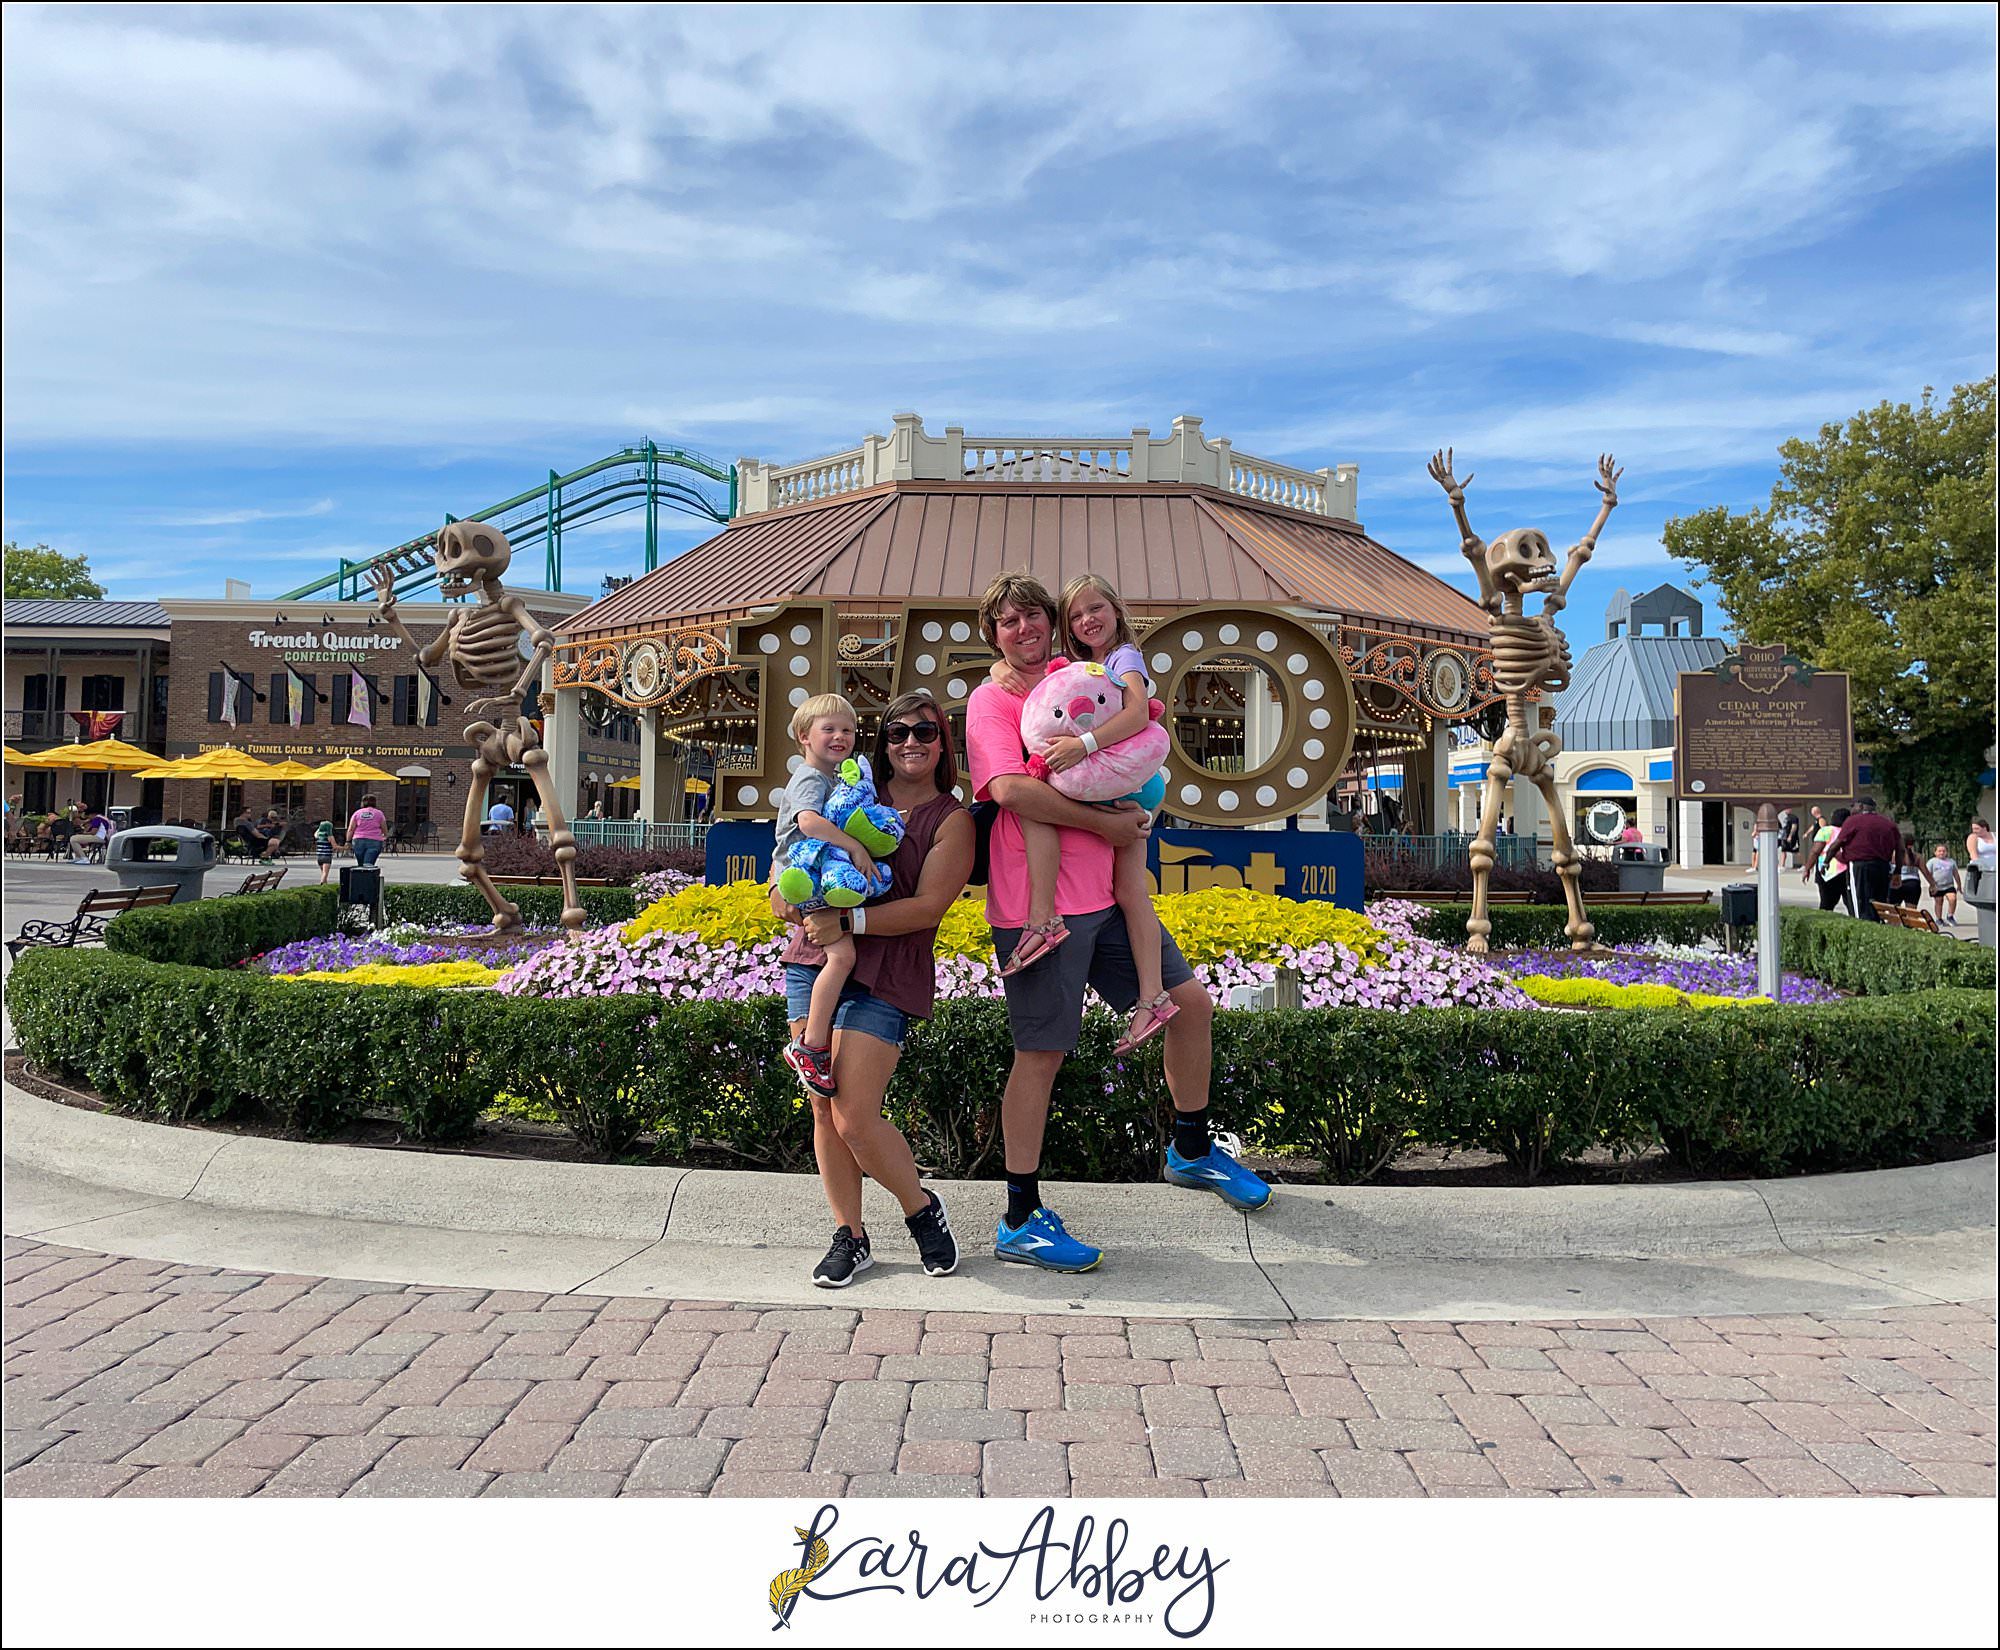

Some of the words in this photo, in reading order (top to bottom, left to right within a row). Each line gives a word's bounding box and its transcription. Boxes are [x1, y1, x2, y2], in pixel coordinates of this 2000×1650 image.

[248, 630, 320, 649] French
[322, 631, 402, 651] Quarter
[284, 651, 366, 663] CONFECTIONS
[1749, 652, 1775, 662] OHIO
[1718, 701, 1760, 711] CEDAR
[1768, 701, 1807, 711] POINT
[1755, 711, 1784, 719] Queen
[1785, 711, 1795, 719] of
[1704, 718, 1745, 726] American
[1749, 718, 1788, 727] Watering
[726, 854, 757, 883] 1870
[1301, 864, 1337, 895] 2020
